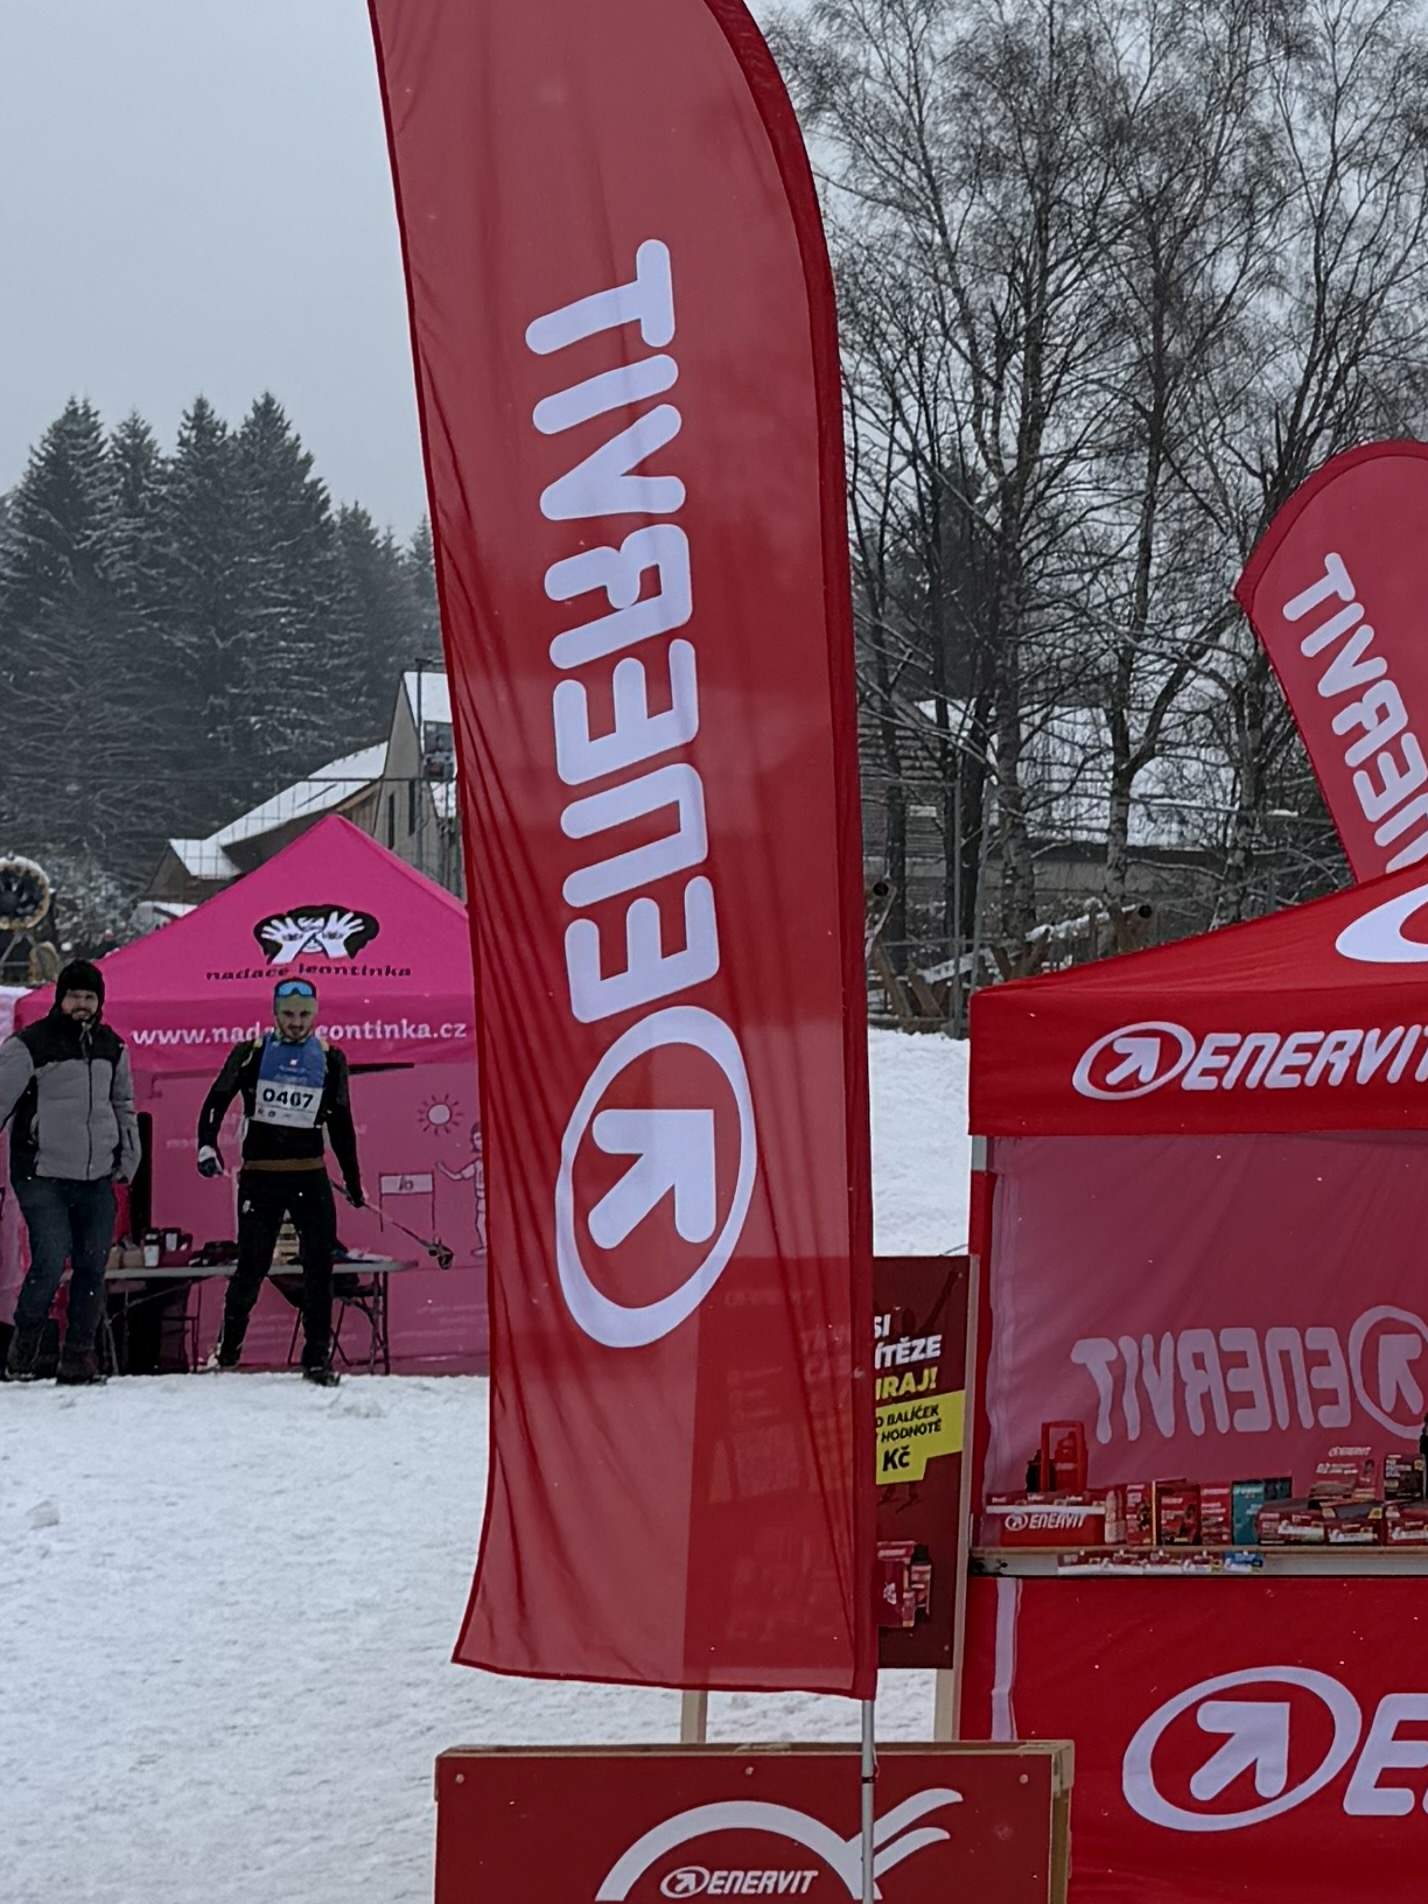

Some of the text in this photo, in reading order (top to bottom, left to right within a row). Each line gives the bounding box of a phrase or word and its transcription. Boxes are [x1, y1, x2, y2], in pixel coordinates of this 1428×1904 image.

[874, 1335, 942, 1370] ÍTĚZE
[876, 1367, 938, 1400] RAJ!
[883, 1445, 910, 1471] Kč
[1028, 1514, 1087, 1529] ENERVIT
[707, 1869, 818, 1894] ENERVIT
